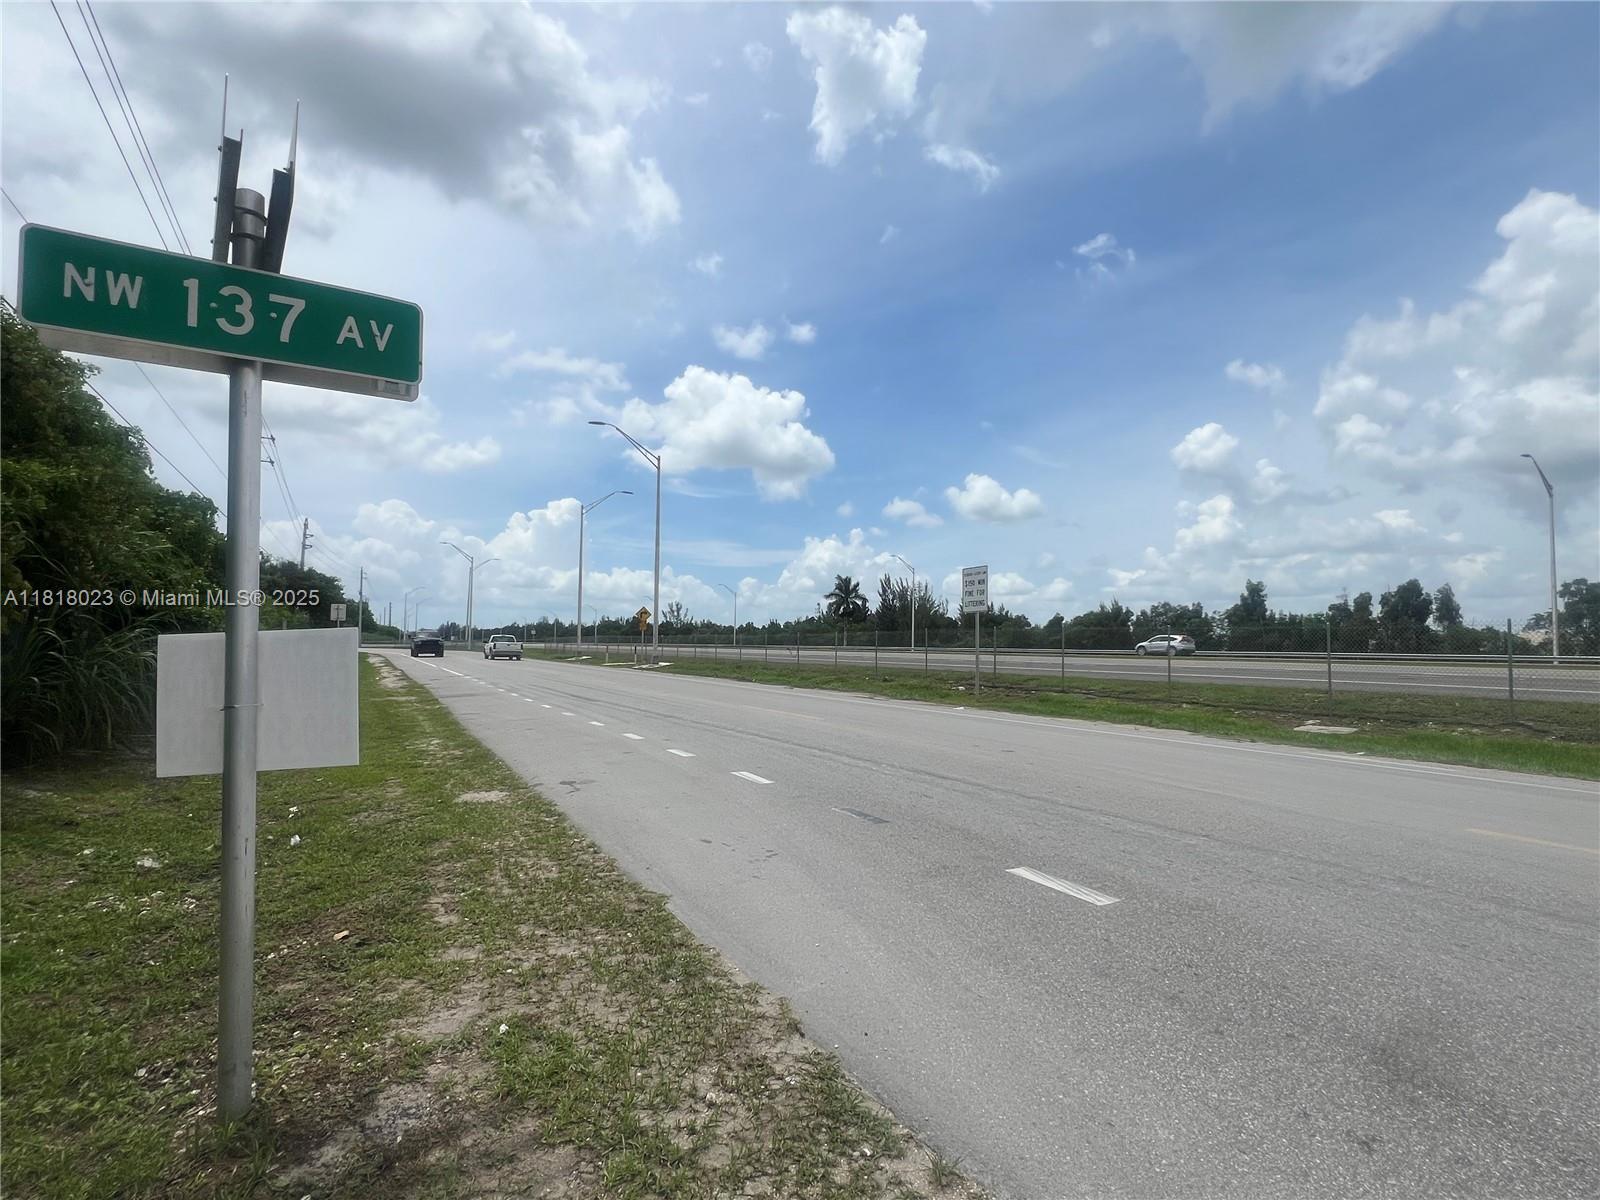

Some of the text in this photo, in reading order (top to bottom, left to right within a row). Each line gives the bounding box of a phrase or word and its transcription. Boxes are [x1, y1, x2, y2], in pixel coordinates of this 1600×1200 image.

[63, 262, 393, 352] NW 137 AV
